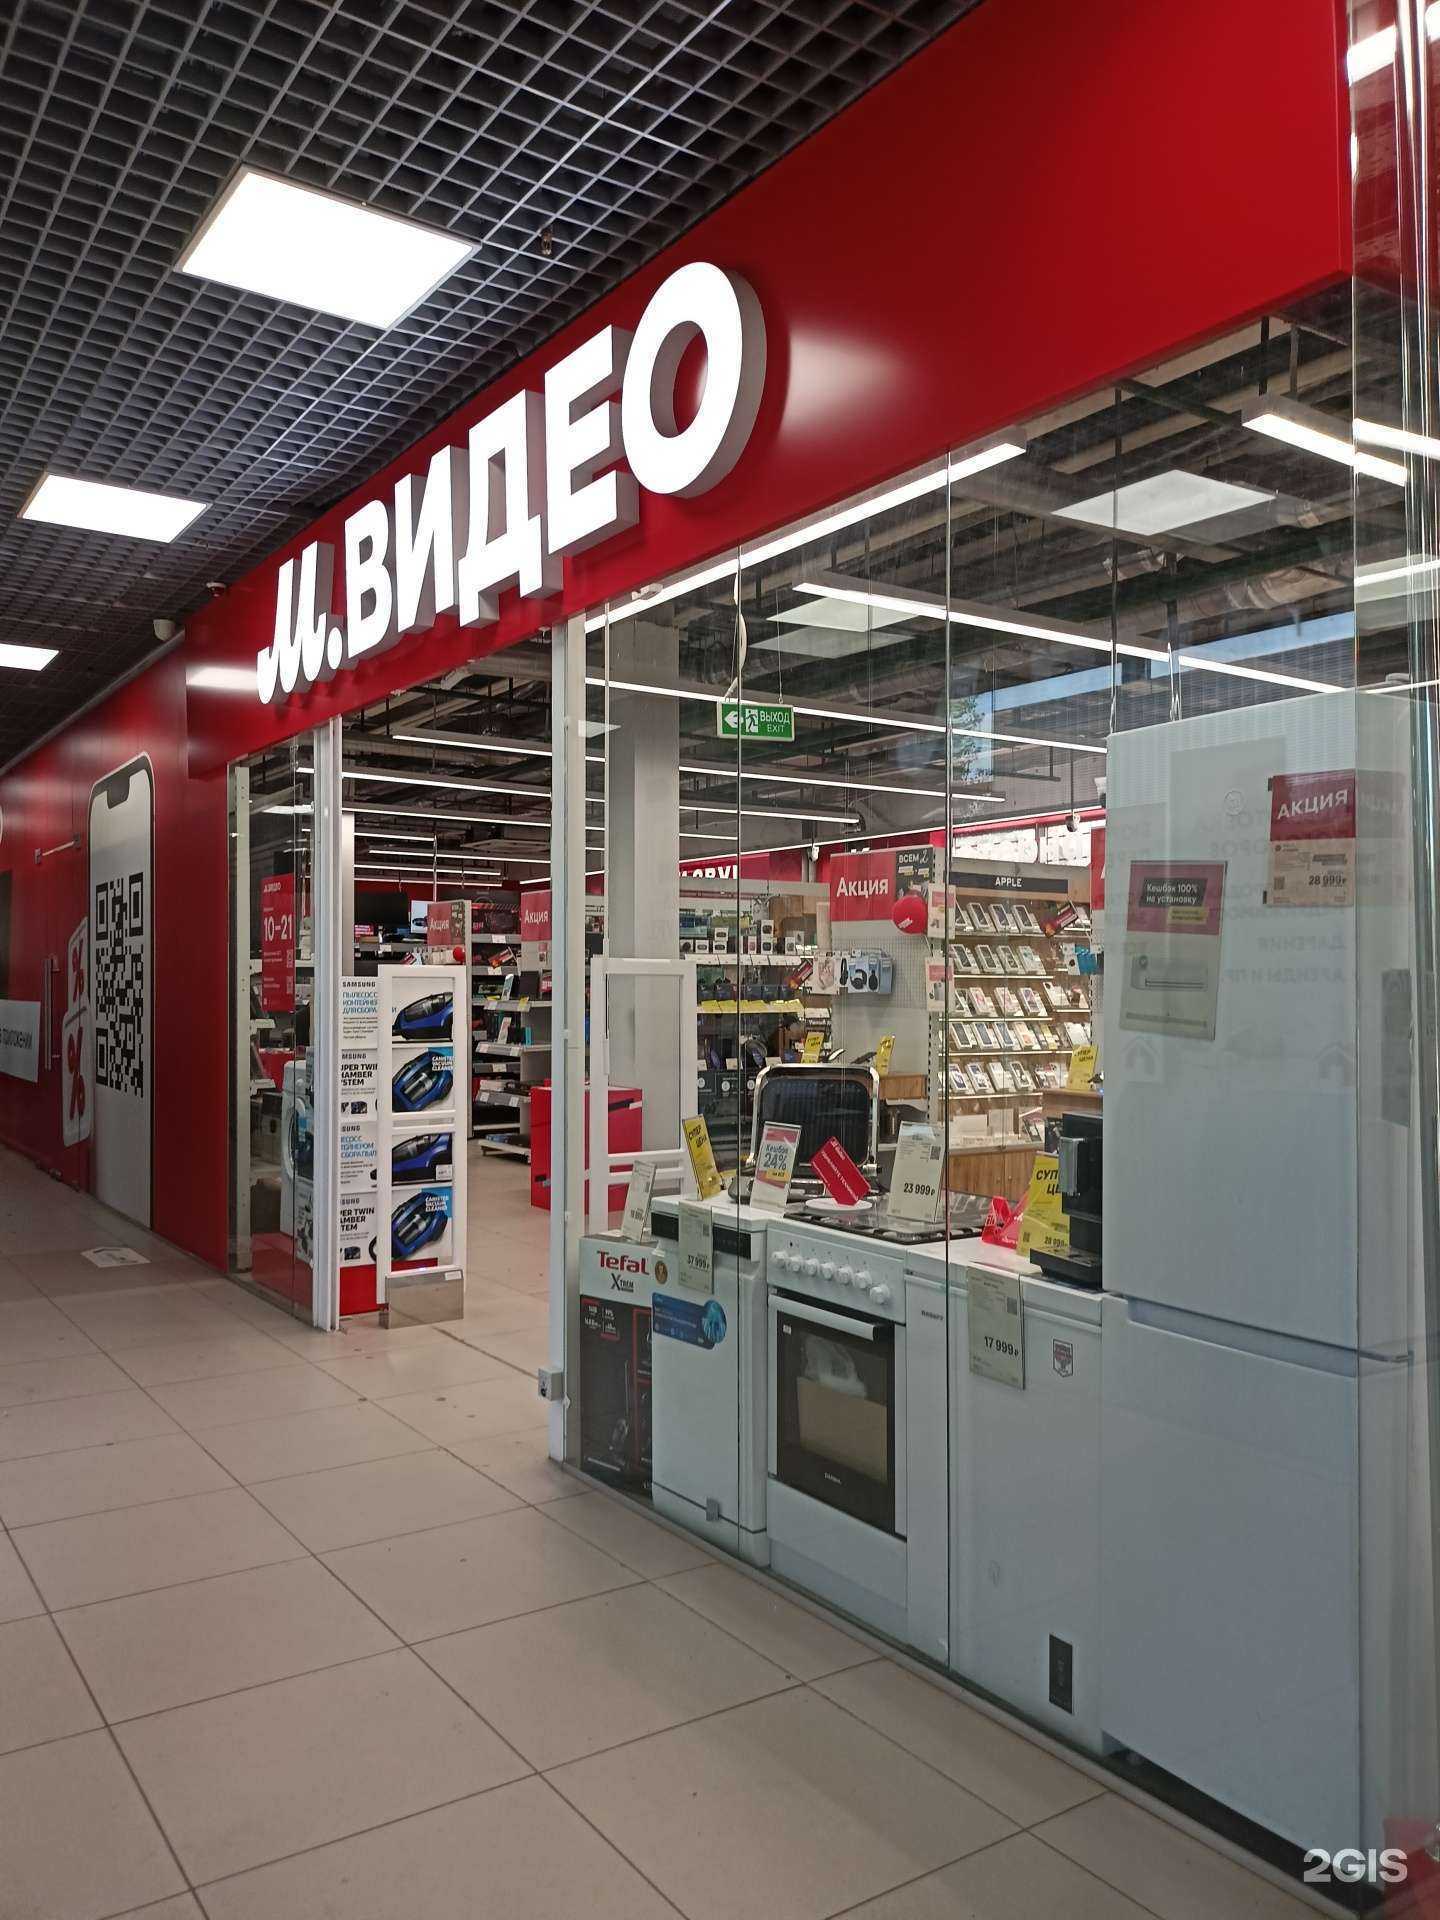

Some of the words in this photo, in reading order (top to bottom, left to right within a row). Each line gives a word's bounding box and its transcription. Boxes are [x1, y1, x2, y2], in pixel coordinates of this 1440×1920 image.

[760, 711, 790, 725] ВЫХОД
[767, 724, 785, 733] EXIT
[1276, 788, 1349, 820] АКЦИЯ
[836, 877, 889, 898] Акция
[995, 876, 1022, 888] APPLE
[1178, 882, 1198, 894] 100%
[1308, 875, 1321, 887] 28
[524, 909, 550, 925] Акция
[429, 918, 450, 932] Акция
[341, 1078, 364, 1086] STEM
[763, 1152, 787, 1171] 24%
[903, 1182, 914, 1194] 23
[354, 1207, 375, 1216] TWIN
[597, 1250, 650, 1276] Tefal
[984, 1335, 994, 1349] 17
